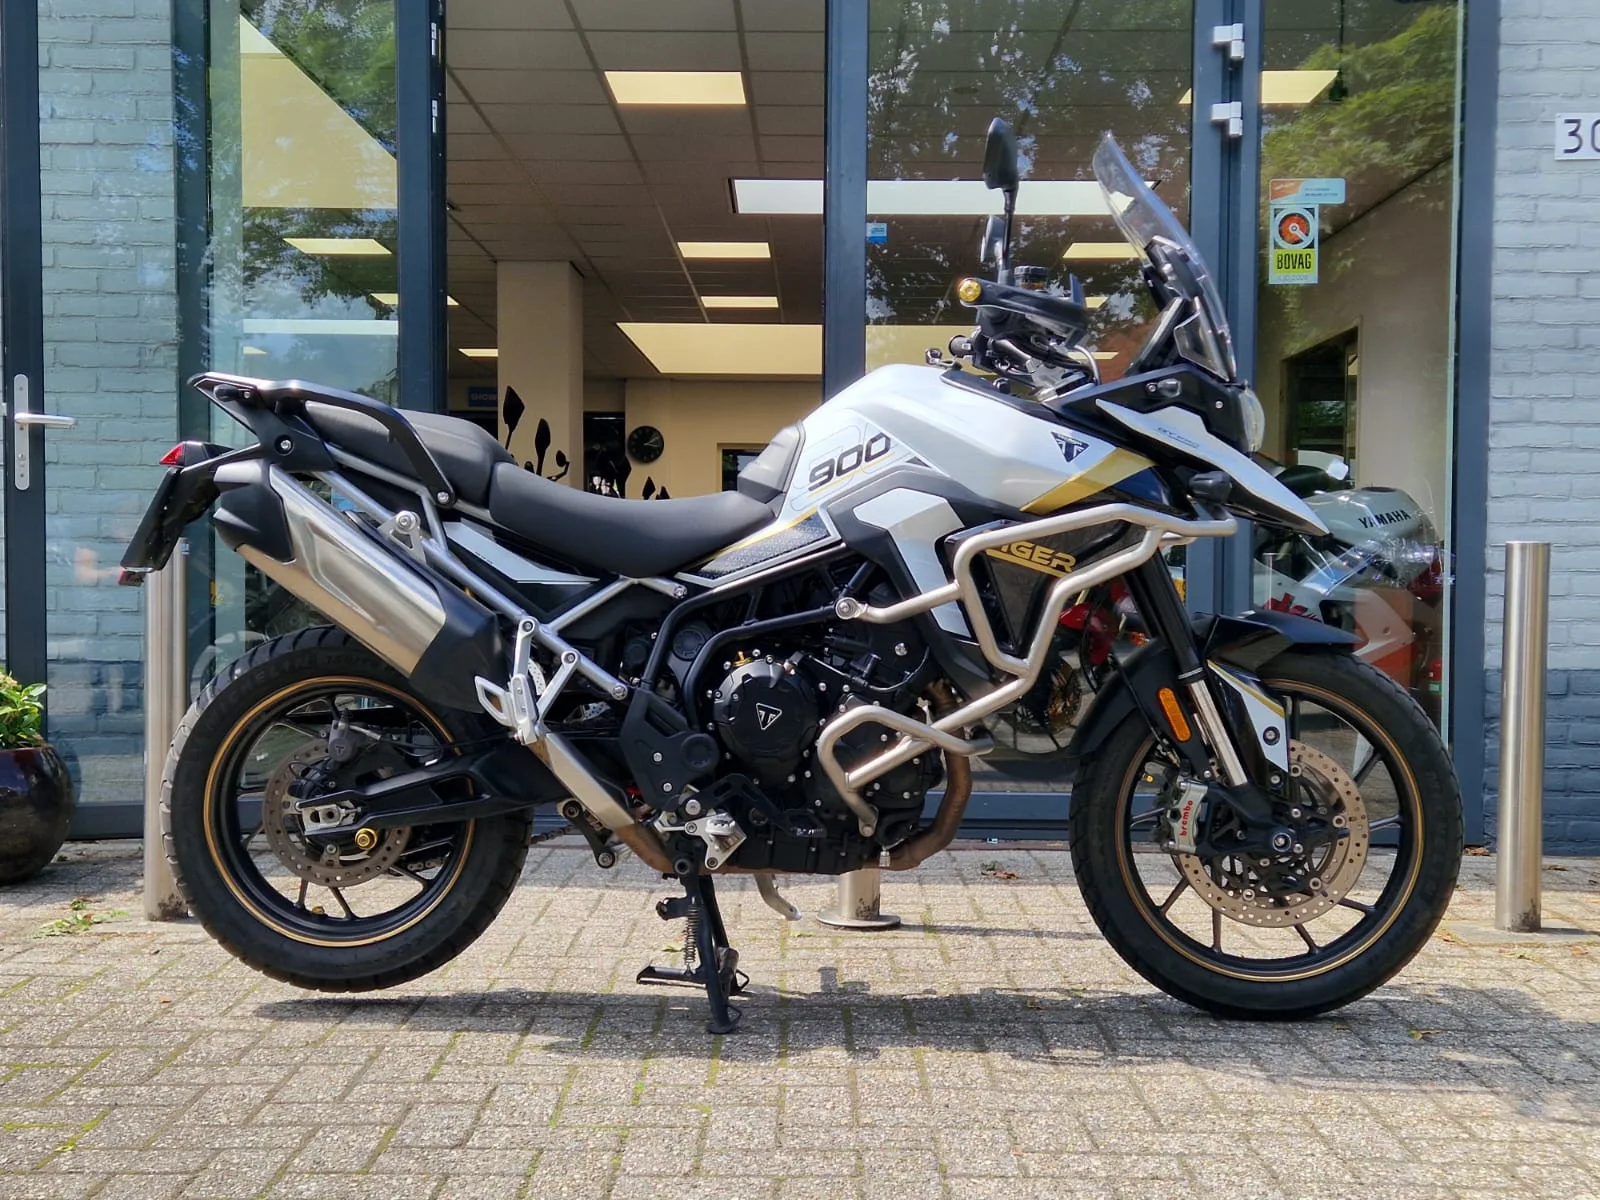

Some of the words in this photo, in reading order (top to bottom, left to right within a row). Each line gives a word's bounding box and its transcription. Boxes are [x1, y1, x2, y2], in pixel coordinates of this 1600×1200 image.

[1277, 252, 1311, 269] BOVAG
[808, 432, 891, 491] 900
[1358, 509, 1411, 528] YAMAHA
[1000, 541, 1076, 573] GER
[1180, 800, 1193, 836] brembo
